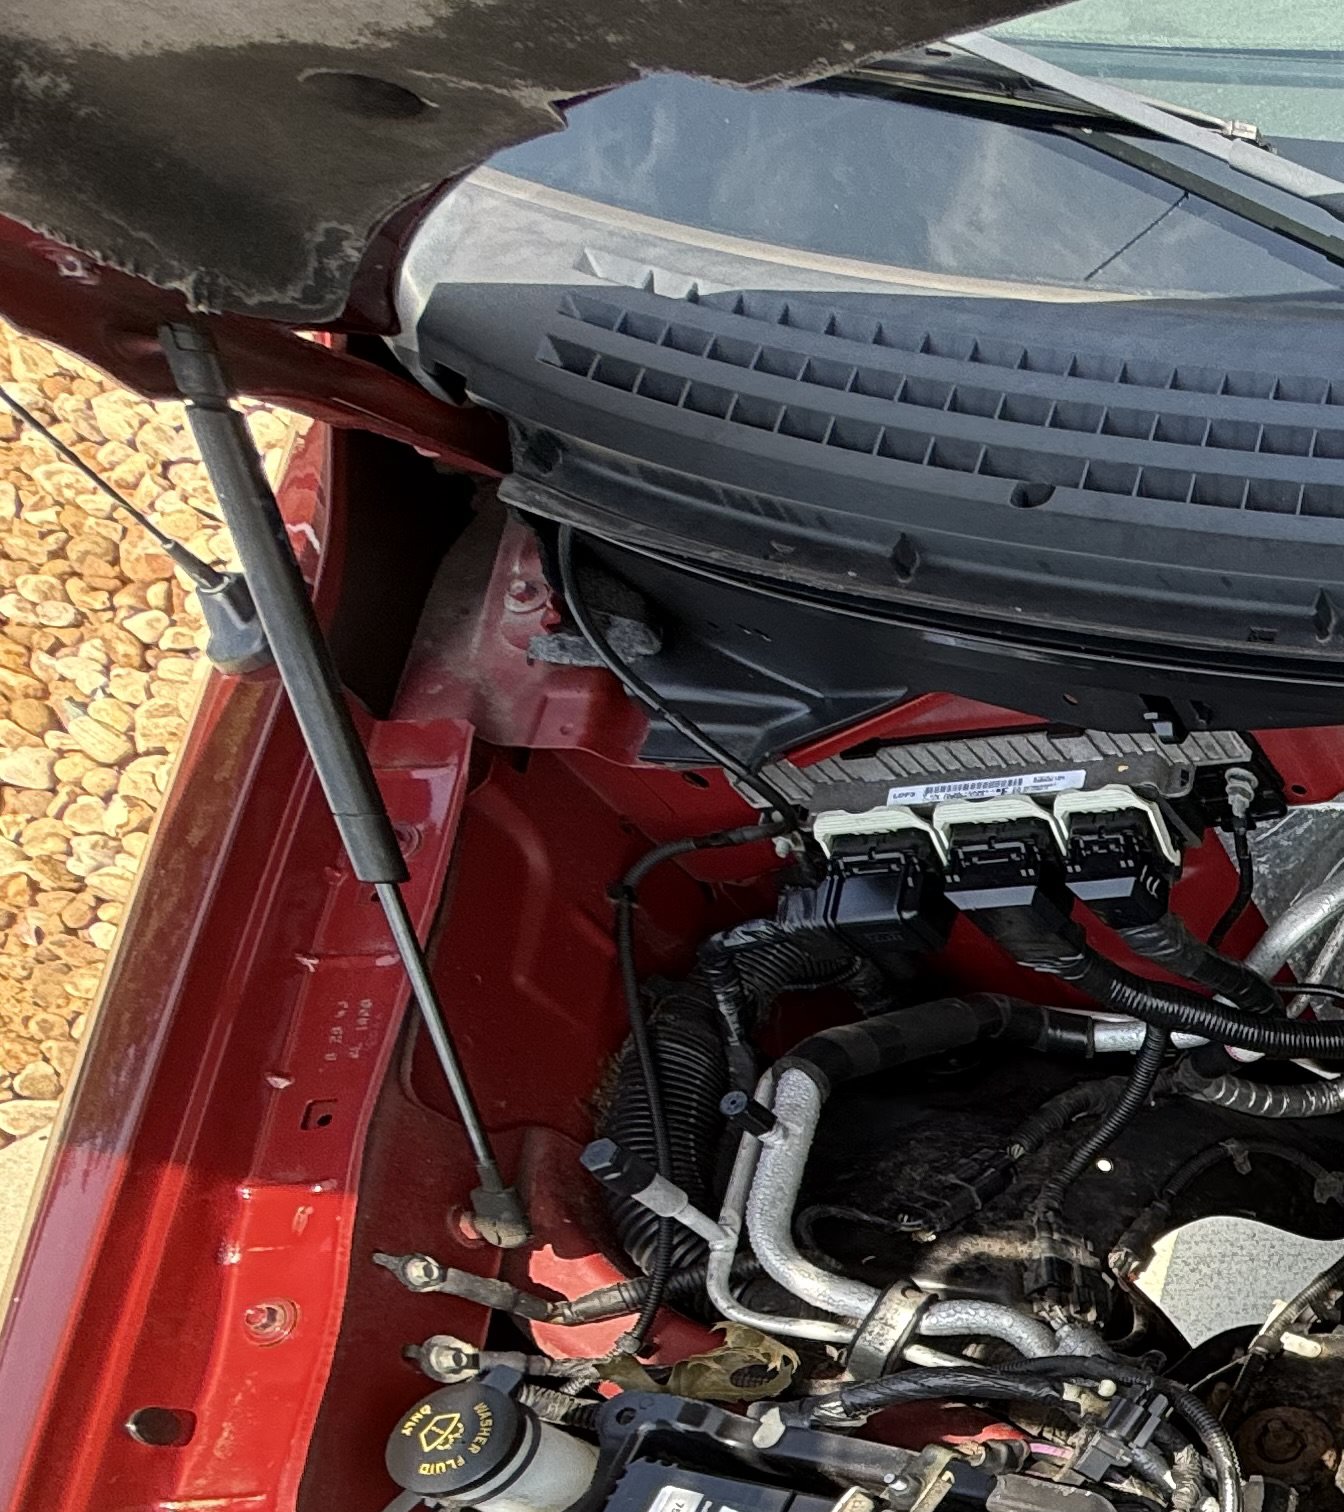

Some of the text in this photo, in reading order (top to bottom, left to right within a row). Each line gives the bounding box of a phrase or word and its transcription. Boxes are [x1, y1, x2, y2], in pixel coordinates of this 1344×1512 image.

[401, 1402, 493, 1474] WASHER FLUID ONLY
